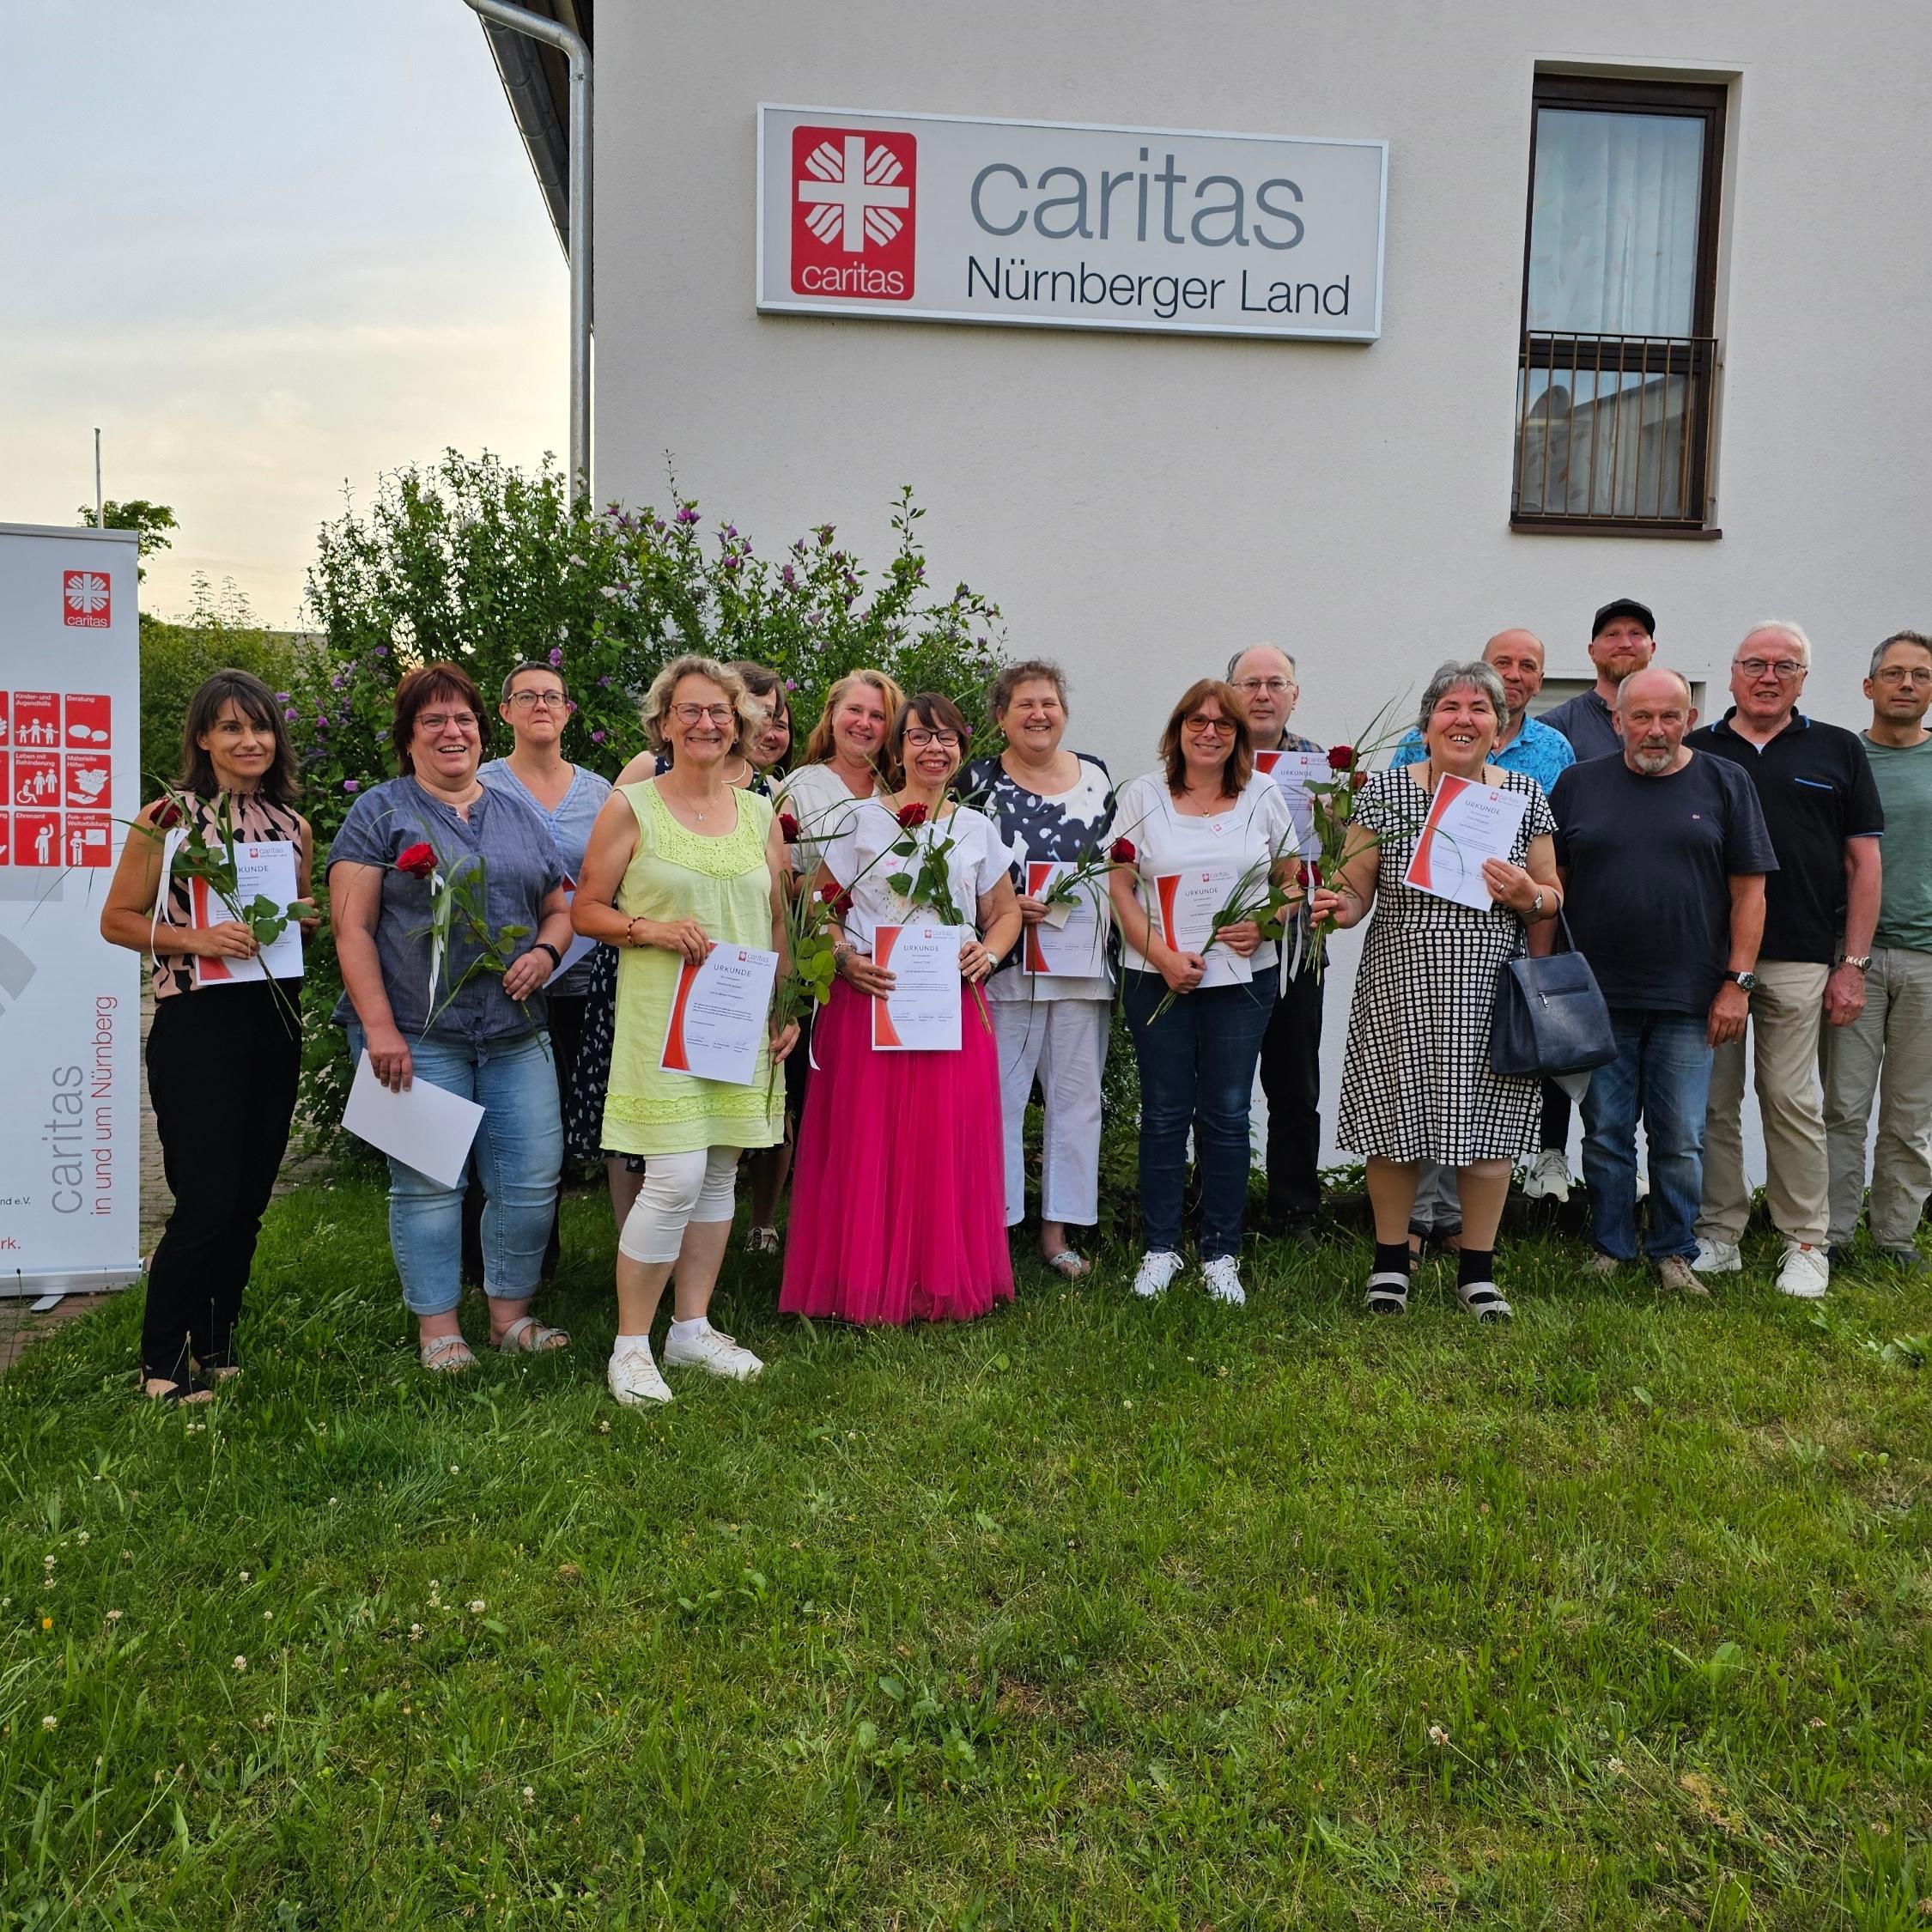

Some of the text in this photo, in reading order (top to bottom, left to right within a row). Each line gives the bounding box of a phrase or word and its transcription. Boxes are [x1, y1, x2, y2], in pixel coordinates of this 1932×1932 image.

[970, 147, 1306, 251] caritas
[801, 261, 905, 295] caritas
[967, 255, 1351, 319] Nürnberger Land
[67, 615, 108, 627] caritas
[714, 963, 752, 977] URKUNDE
[90, 996, 118, 1215] in und um Nürnberg
[42, 1065, 83, 1213] caritas
[15, 1196, 31, 1205] e.V.
